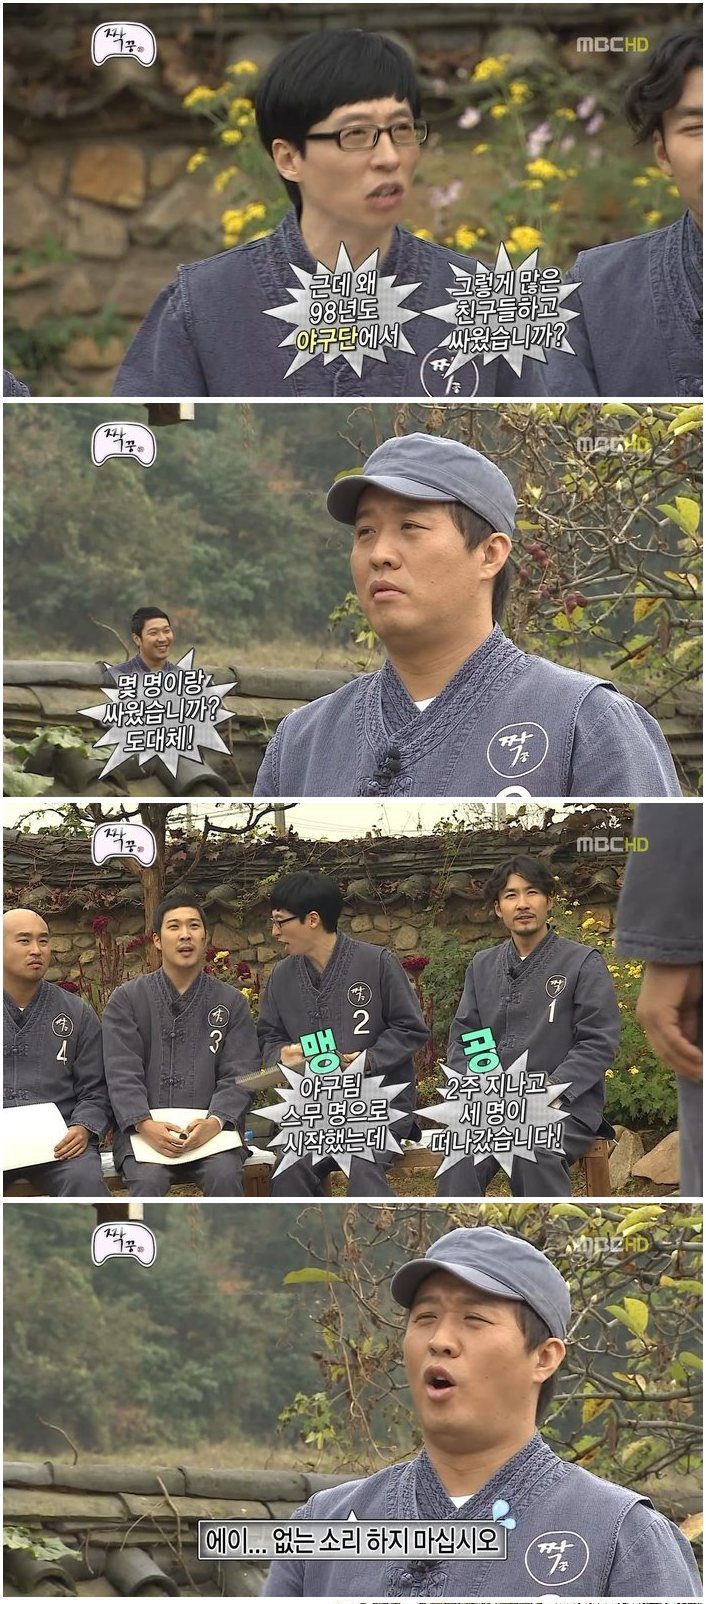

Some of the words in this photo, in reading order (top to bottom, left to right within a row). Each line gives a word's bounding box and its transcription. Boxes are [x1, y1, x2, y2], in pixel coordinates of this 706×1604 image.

[353, 1009, 371, 1035] 2
[548, 999, 557, 1023] 1
[56, 1039, 68, 1065] 4
